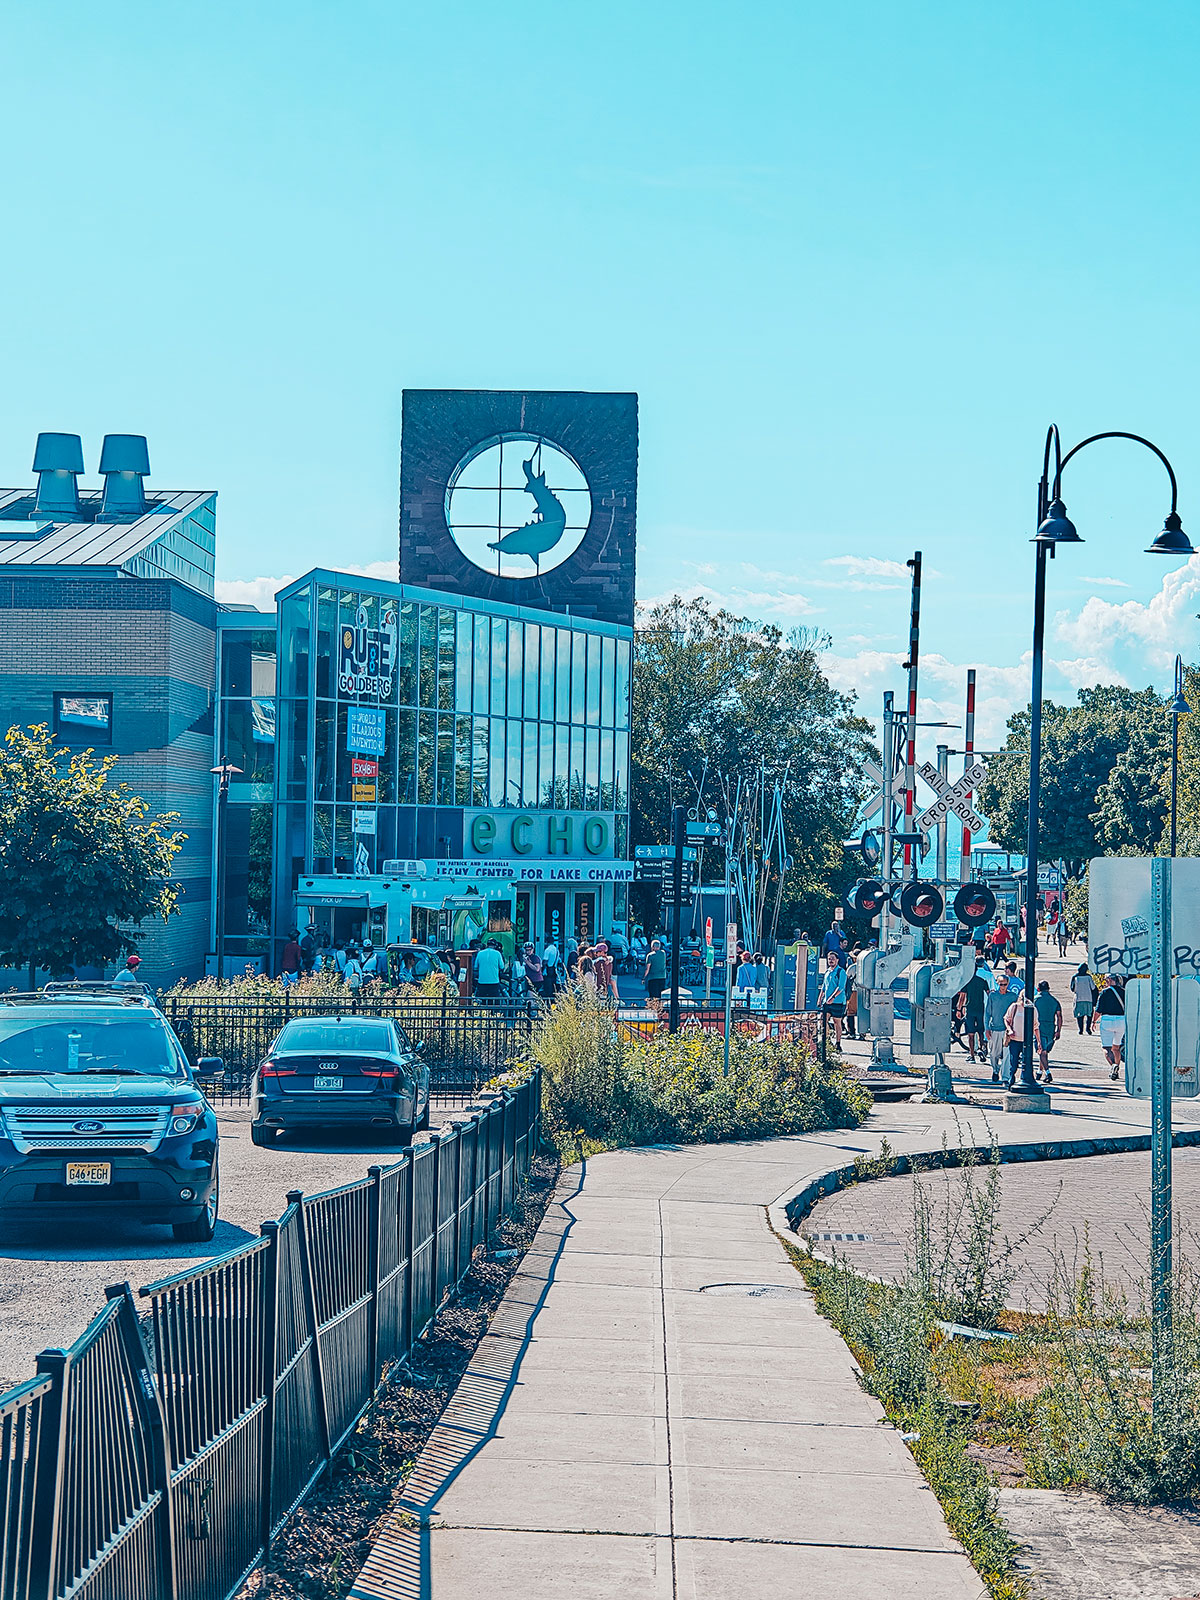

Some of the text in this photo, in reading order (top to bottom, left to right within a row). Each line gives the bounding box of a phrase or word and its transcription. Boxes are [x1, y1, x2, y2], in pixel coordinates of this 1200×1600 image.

[341, 624, 391, 677] RUBE
[340, 674, 391, 698] GOLDBERG
[353, 763, 376, 776] EXHIBIT
[921, 764, 981, 835] RAIL ROAD
[922, 770, 982, 827] CROSSING
[521, 869, 543, 880] FOR
[550, 869, 581, 880] LAKE
[80, 1122, 98, 1130] Ford
[69, 1168, 108, 1180] G46 EGH
